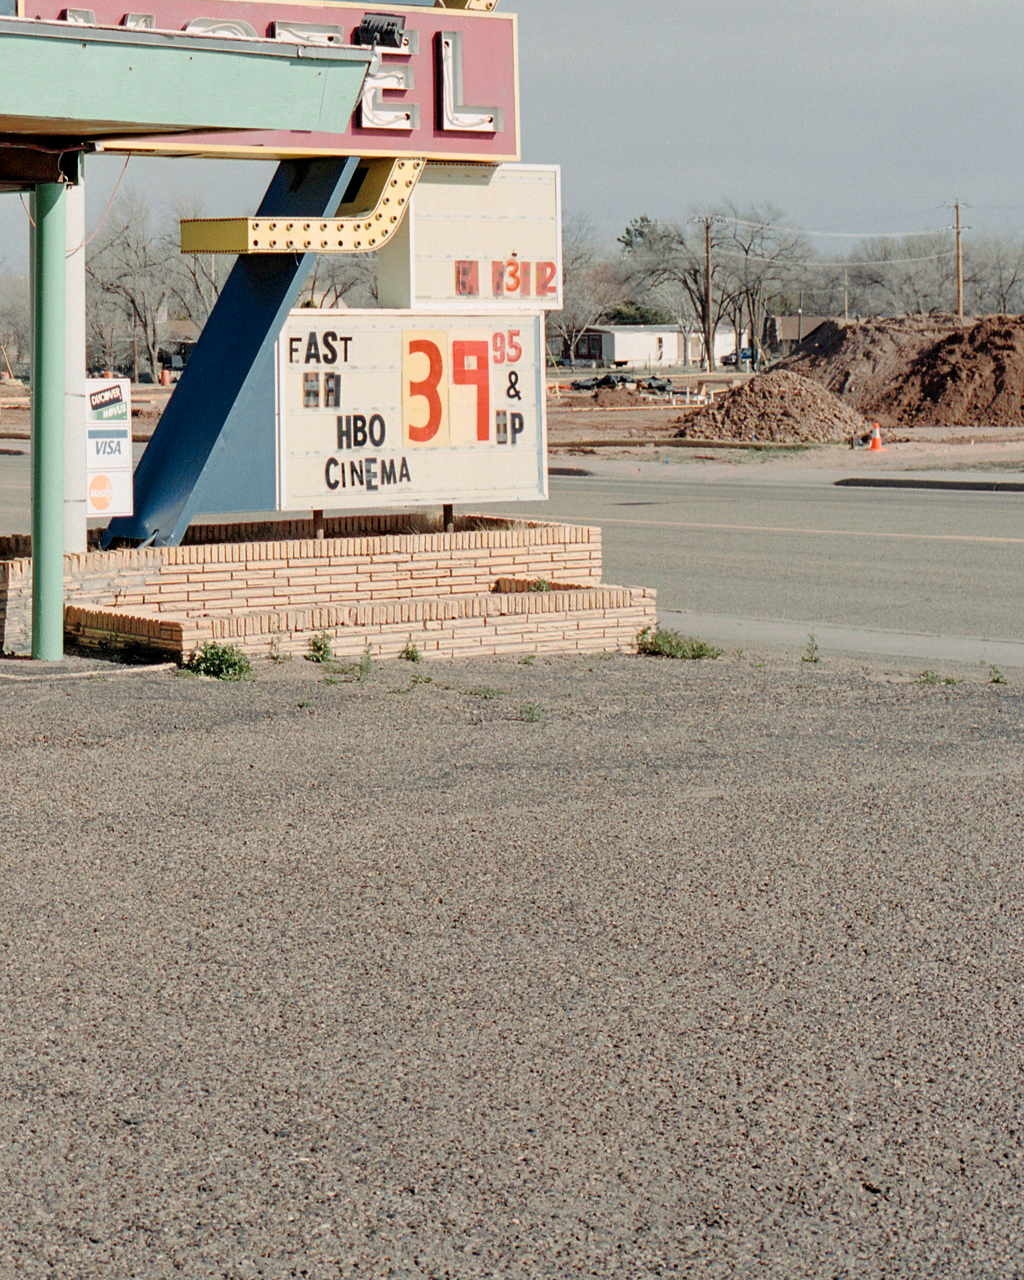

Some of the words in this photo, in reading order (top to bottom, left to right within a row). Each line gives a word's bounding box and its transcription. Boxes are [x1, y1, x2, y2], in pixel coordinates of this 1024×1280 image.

[289, 330, 353, 365] FAST
[408, 338, 490, 443] 39
[492, 329, 522, 364] 95
[506, 370, 522, 401] &
[95, 440, 122, 455] VISA
[336, 413, 386, 450] HBO
[324, 456, 412, 492] CINEMA
